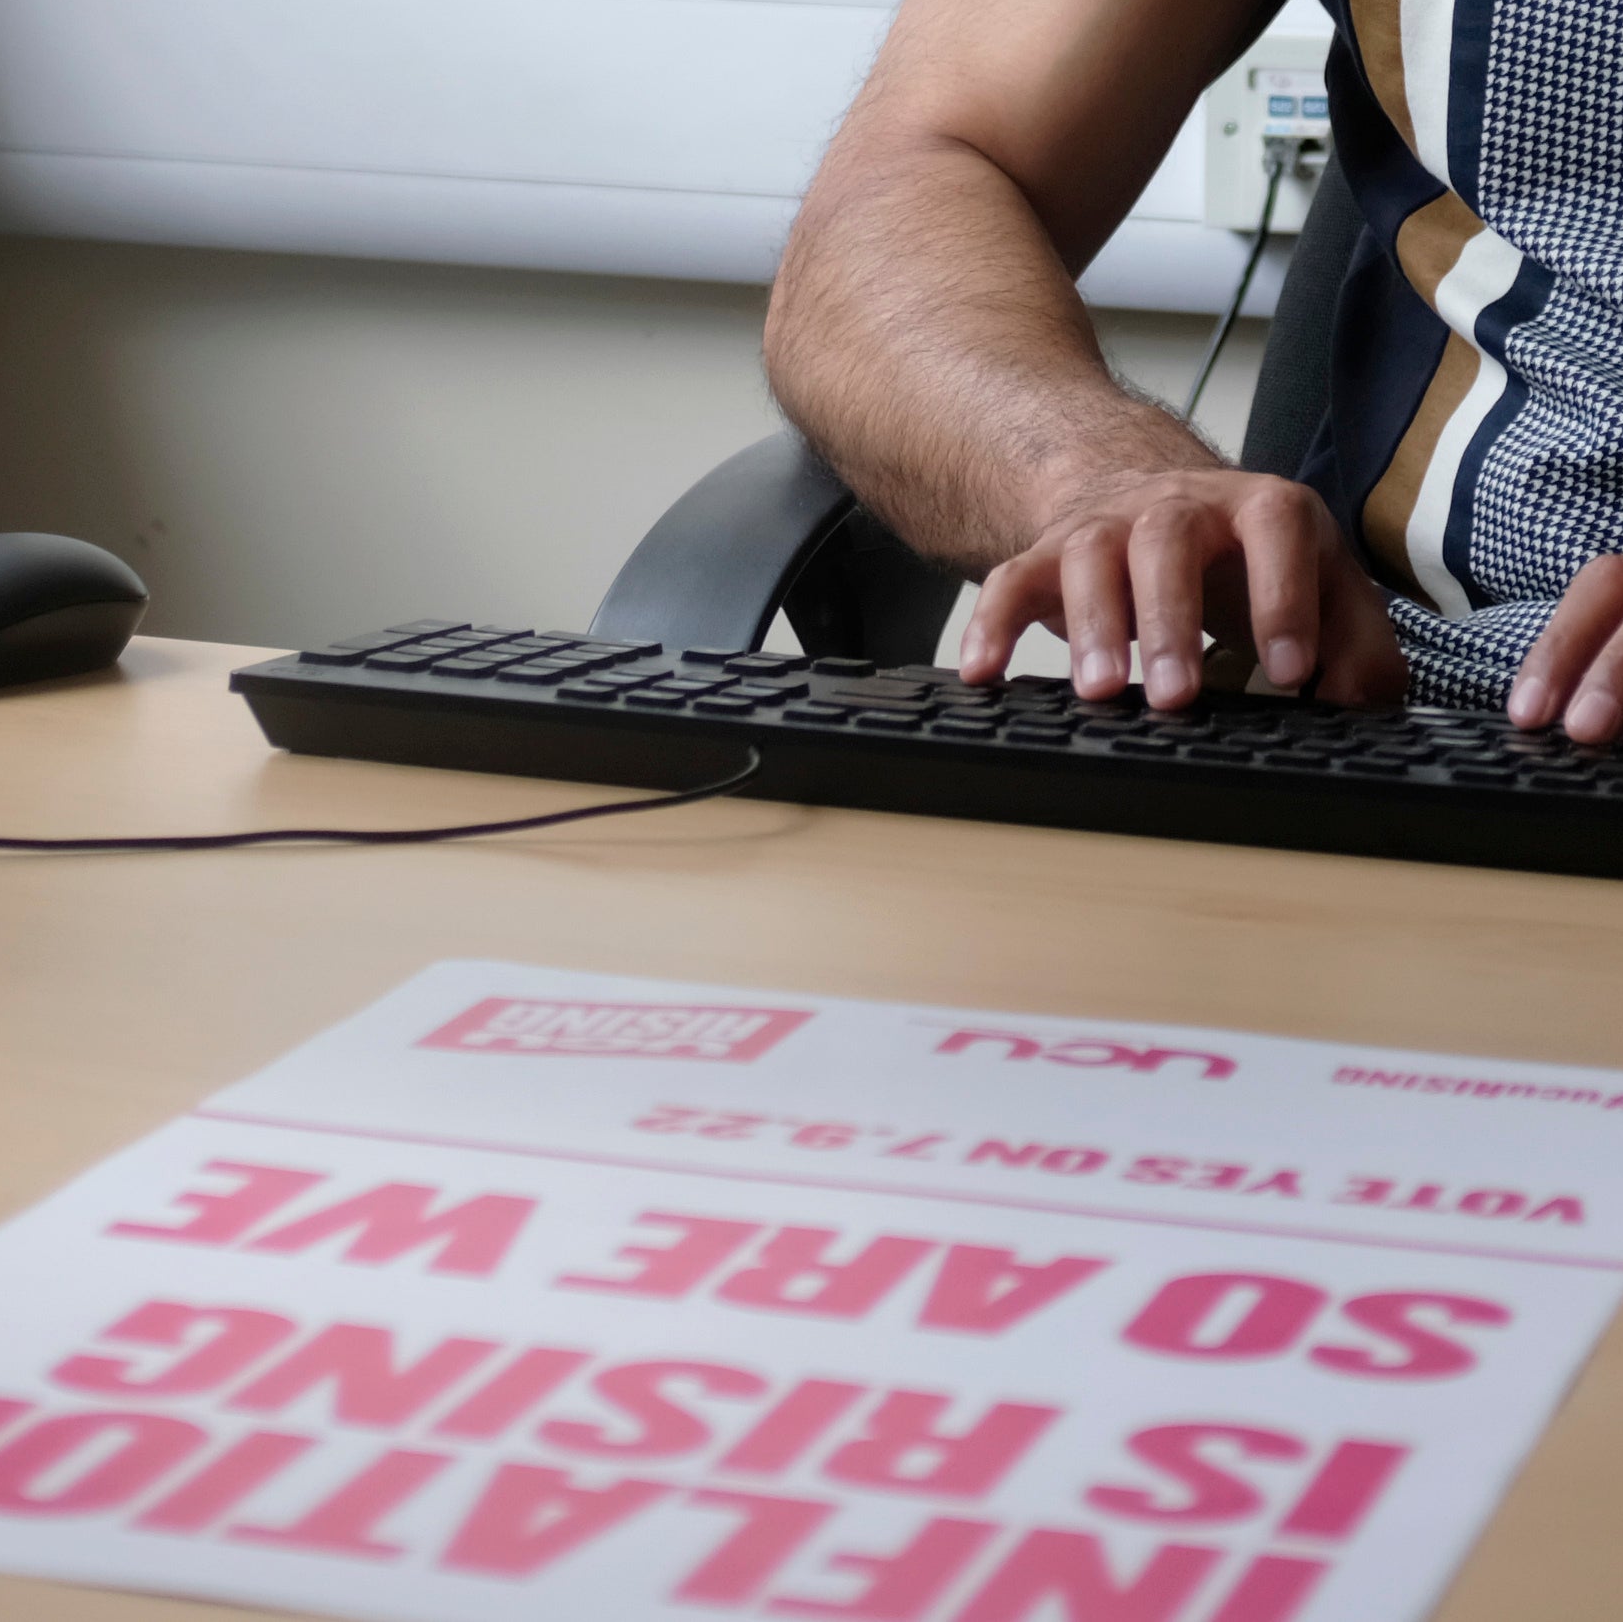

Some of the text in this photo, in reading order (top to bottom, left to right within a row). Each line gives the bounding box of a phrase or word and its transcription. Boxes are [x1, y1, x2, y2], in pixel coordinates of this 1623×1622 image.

[486, 1002, 771, 1044] RISING
[633, 1106, 1585, 1225] VOTE YES ON 7.9.22
[106, 1158, 1511, 1380] SO ARE WE
[49, 1299, 1410, 1543] IS RISING
